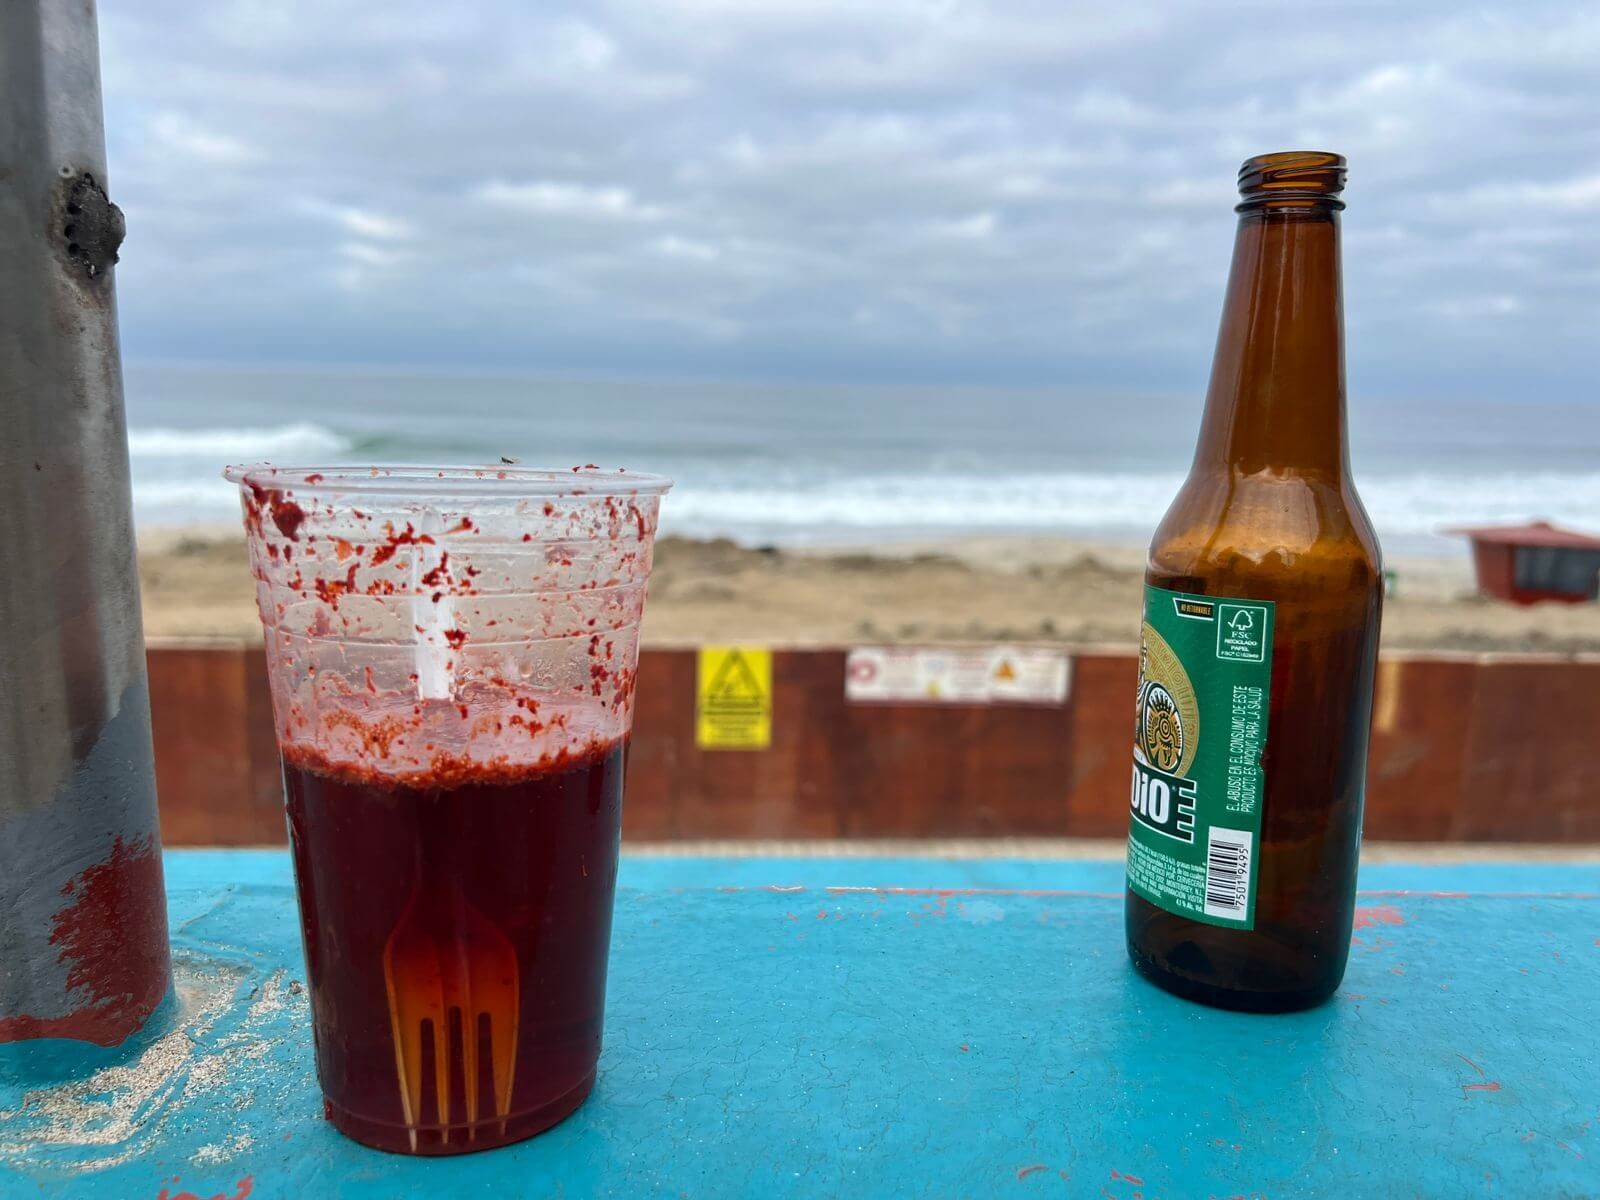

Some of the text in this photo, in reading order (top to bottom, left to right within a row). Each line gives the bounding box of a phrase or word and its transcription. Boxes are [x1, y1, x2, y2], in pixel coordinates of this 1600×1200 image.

[1224, 638, 1258, 646] RECICLADO
[1231, 631, 1251, 639] FSC
[1226, 685, 1248, 812] EL ABUSO EN EL CONSUMO DE ESTE
[1241, 686, 1262, 813] PRODUCTO ES NOCIVO PARA LA SALUD
